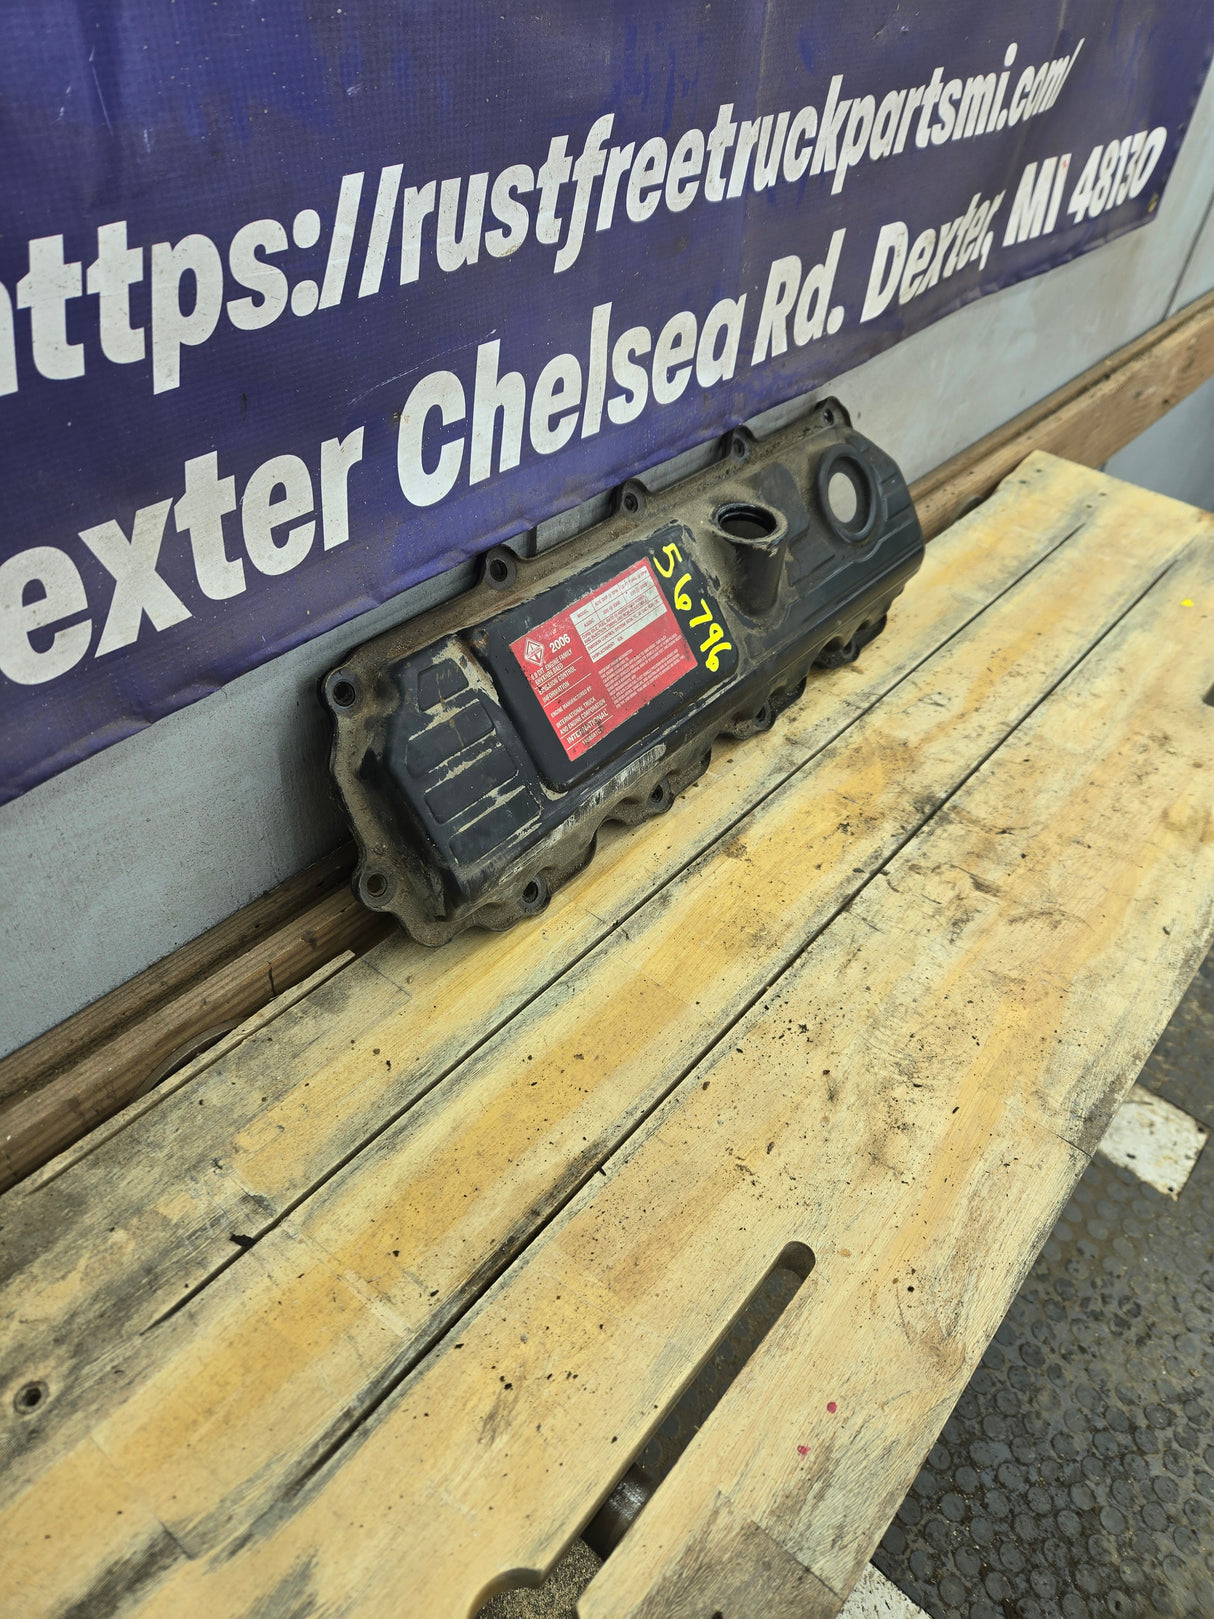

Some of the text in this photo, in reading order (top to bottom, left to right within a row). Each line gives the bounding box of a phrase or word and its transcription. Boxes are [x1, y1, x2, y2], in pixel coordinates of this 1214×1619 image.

[397, 293, 747, 506] Chelsea
[751, 229, 844, 366] Rd.
[860, 190, 1005, 322] Dexter,
[1003, 153, 1072, 247] MI
[1067, 127, 1167, 224] 48130
[653, 543, 731, 672] 56796
[549, 633, 571, 653] 2006
[544, 656, 560, 670] ENGINE
[558, 648, 573, 661] FAMILY
[557, 665, 576, 681] CONTROL
[541, 680, 570, 702] INFORMATION
[561, 688, 588, 709] MANUFACTURED
[555, 696, 596, 728] INTERNATIONAL TRUCK
[559, 697, 606, 735] AND ENGINE CORPORATION
[565, 709, 608, 744] INTERNATIONAL
